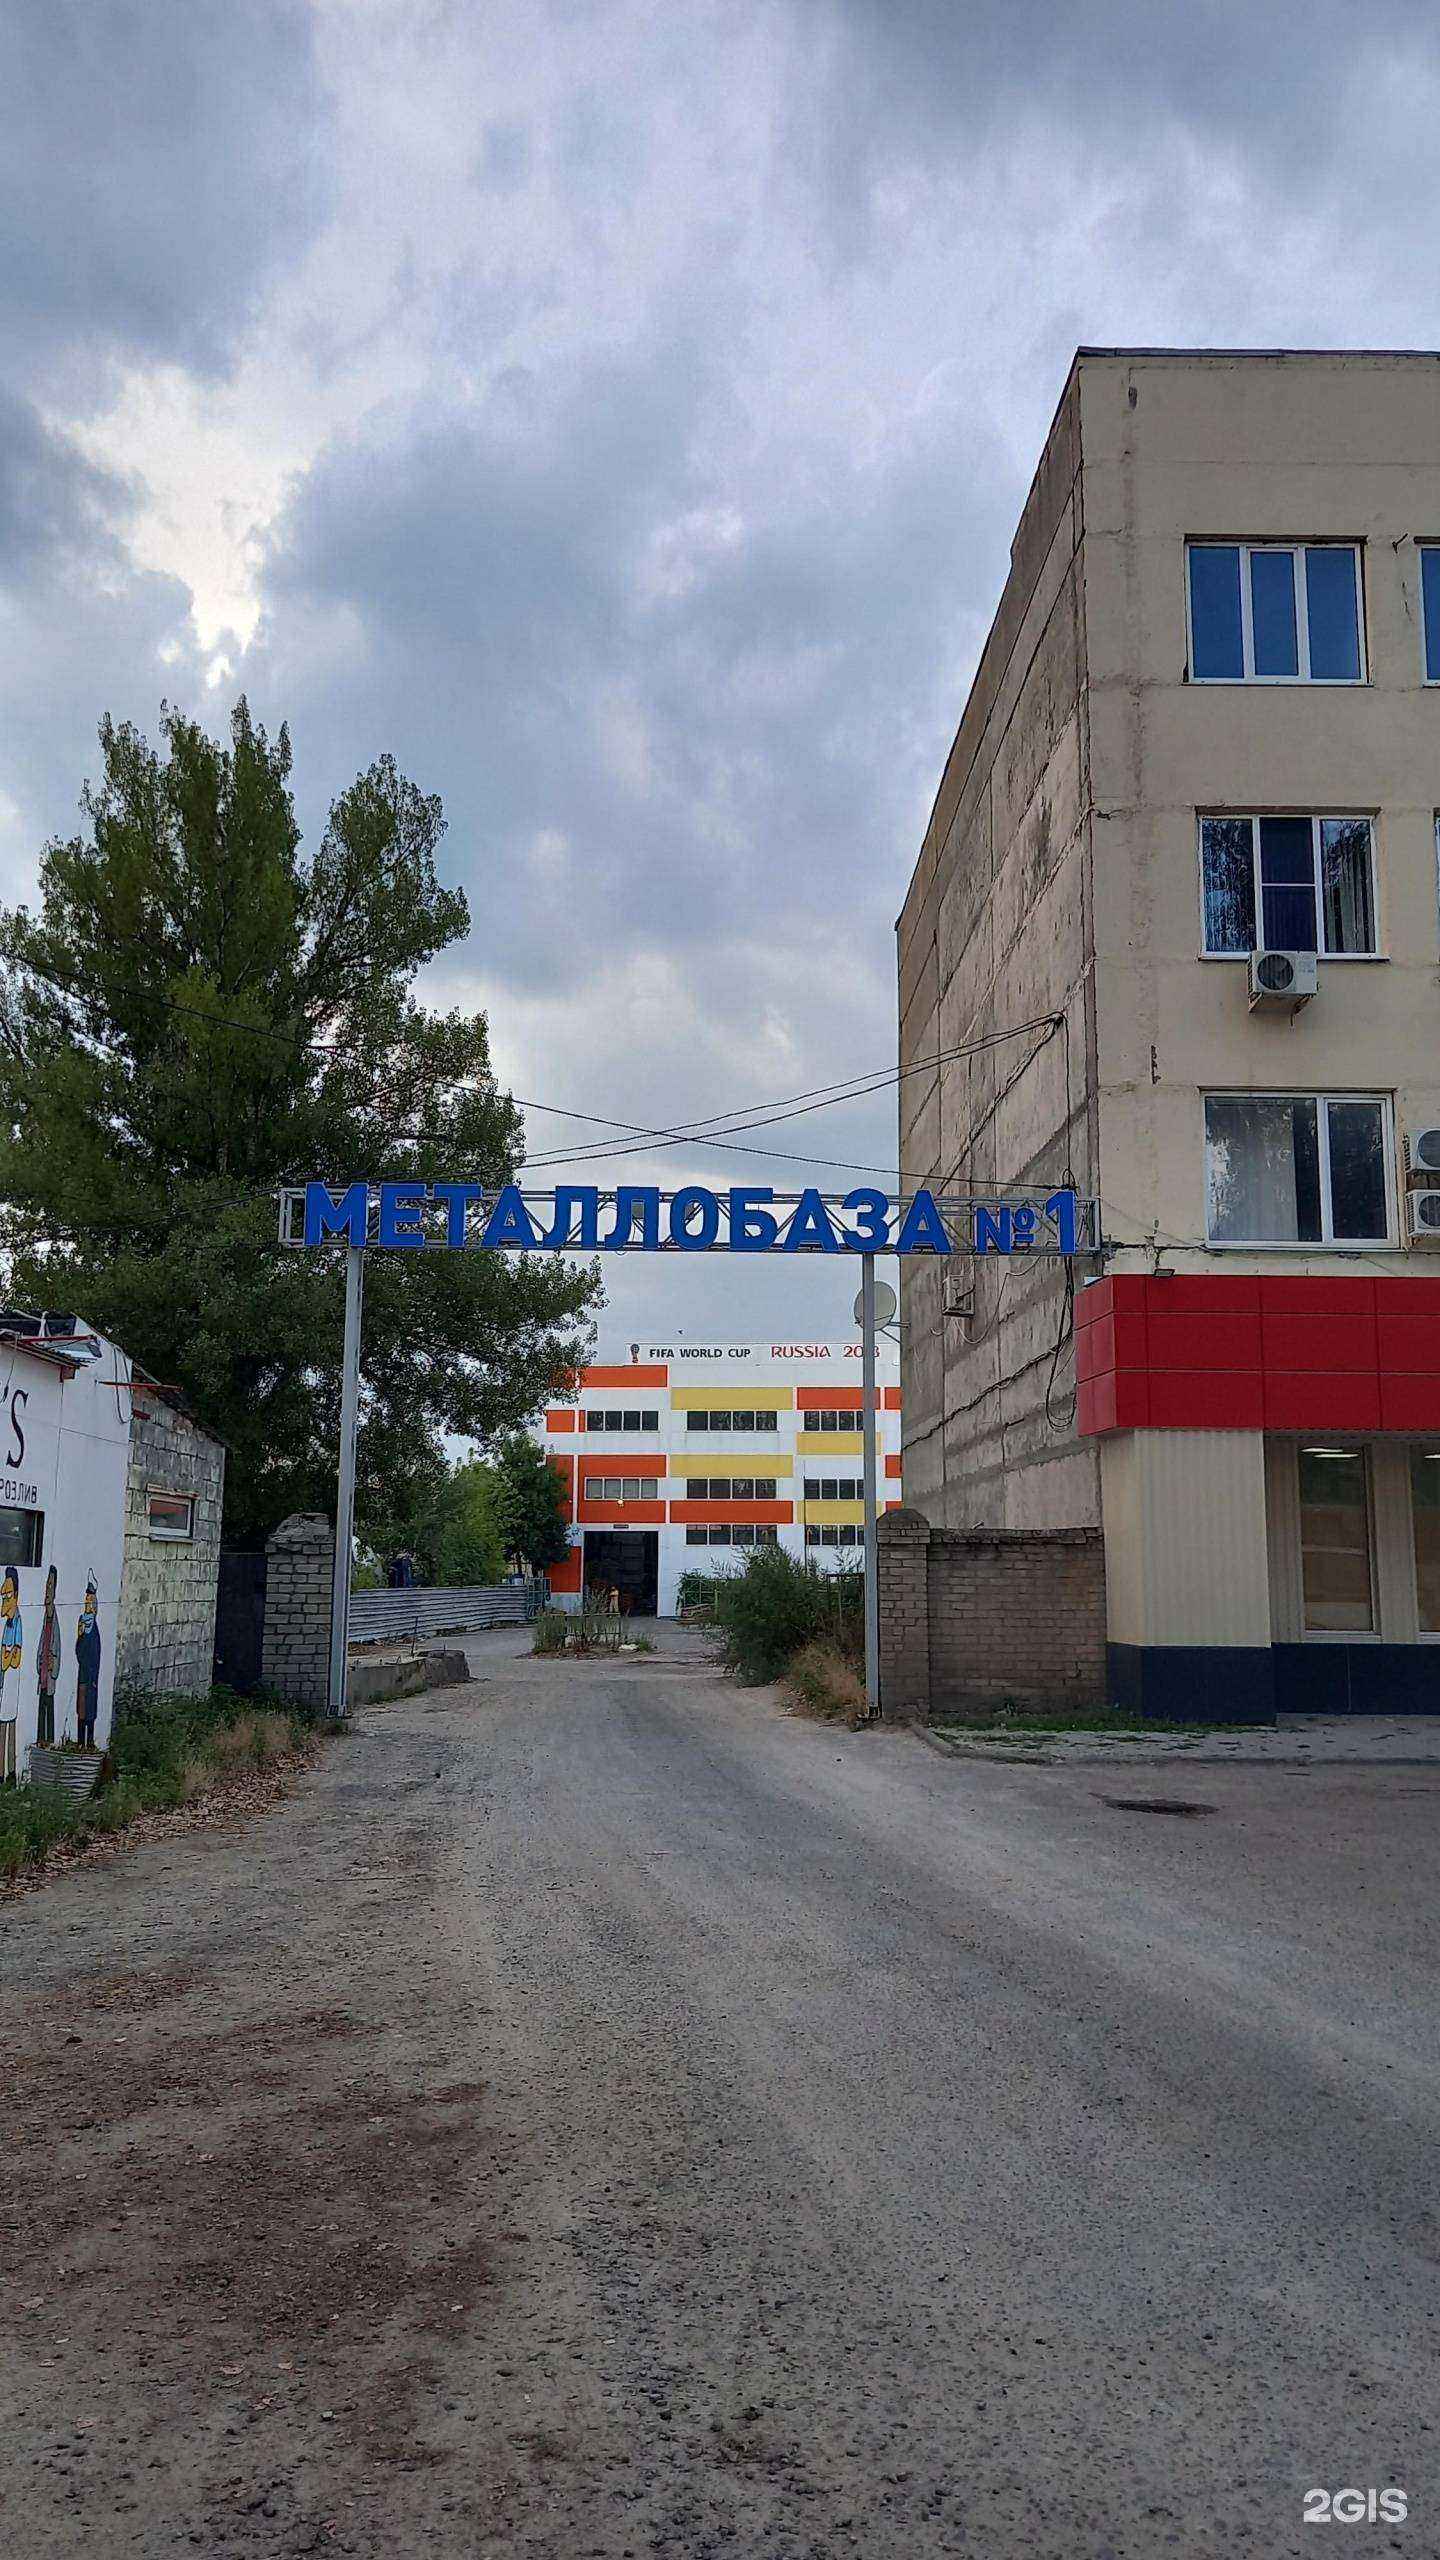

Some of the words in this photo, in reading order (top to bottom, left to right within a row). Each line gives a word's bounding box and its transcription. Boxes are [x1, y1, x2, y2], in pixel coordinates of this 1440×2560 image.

[304, 1181, 953, 1253] МЕТАЛЛОБАЗА
[649, 1348, 675, 1358] FIFA
[680, 1348, 722, 1358] WORLD
[728, 1348, 751, 1358] CUP
[771, 1345, 831, 1358] RUSSIA
